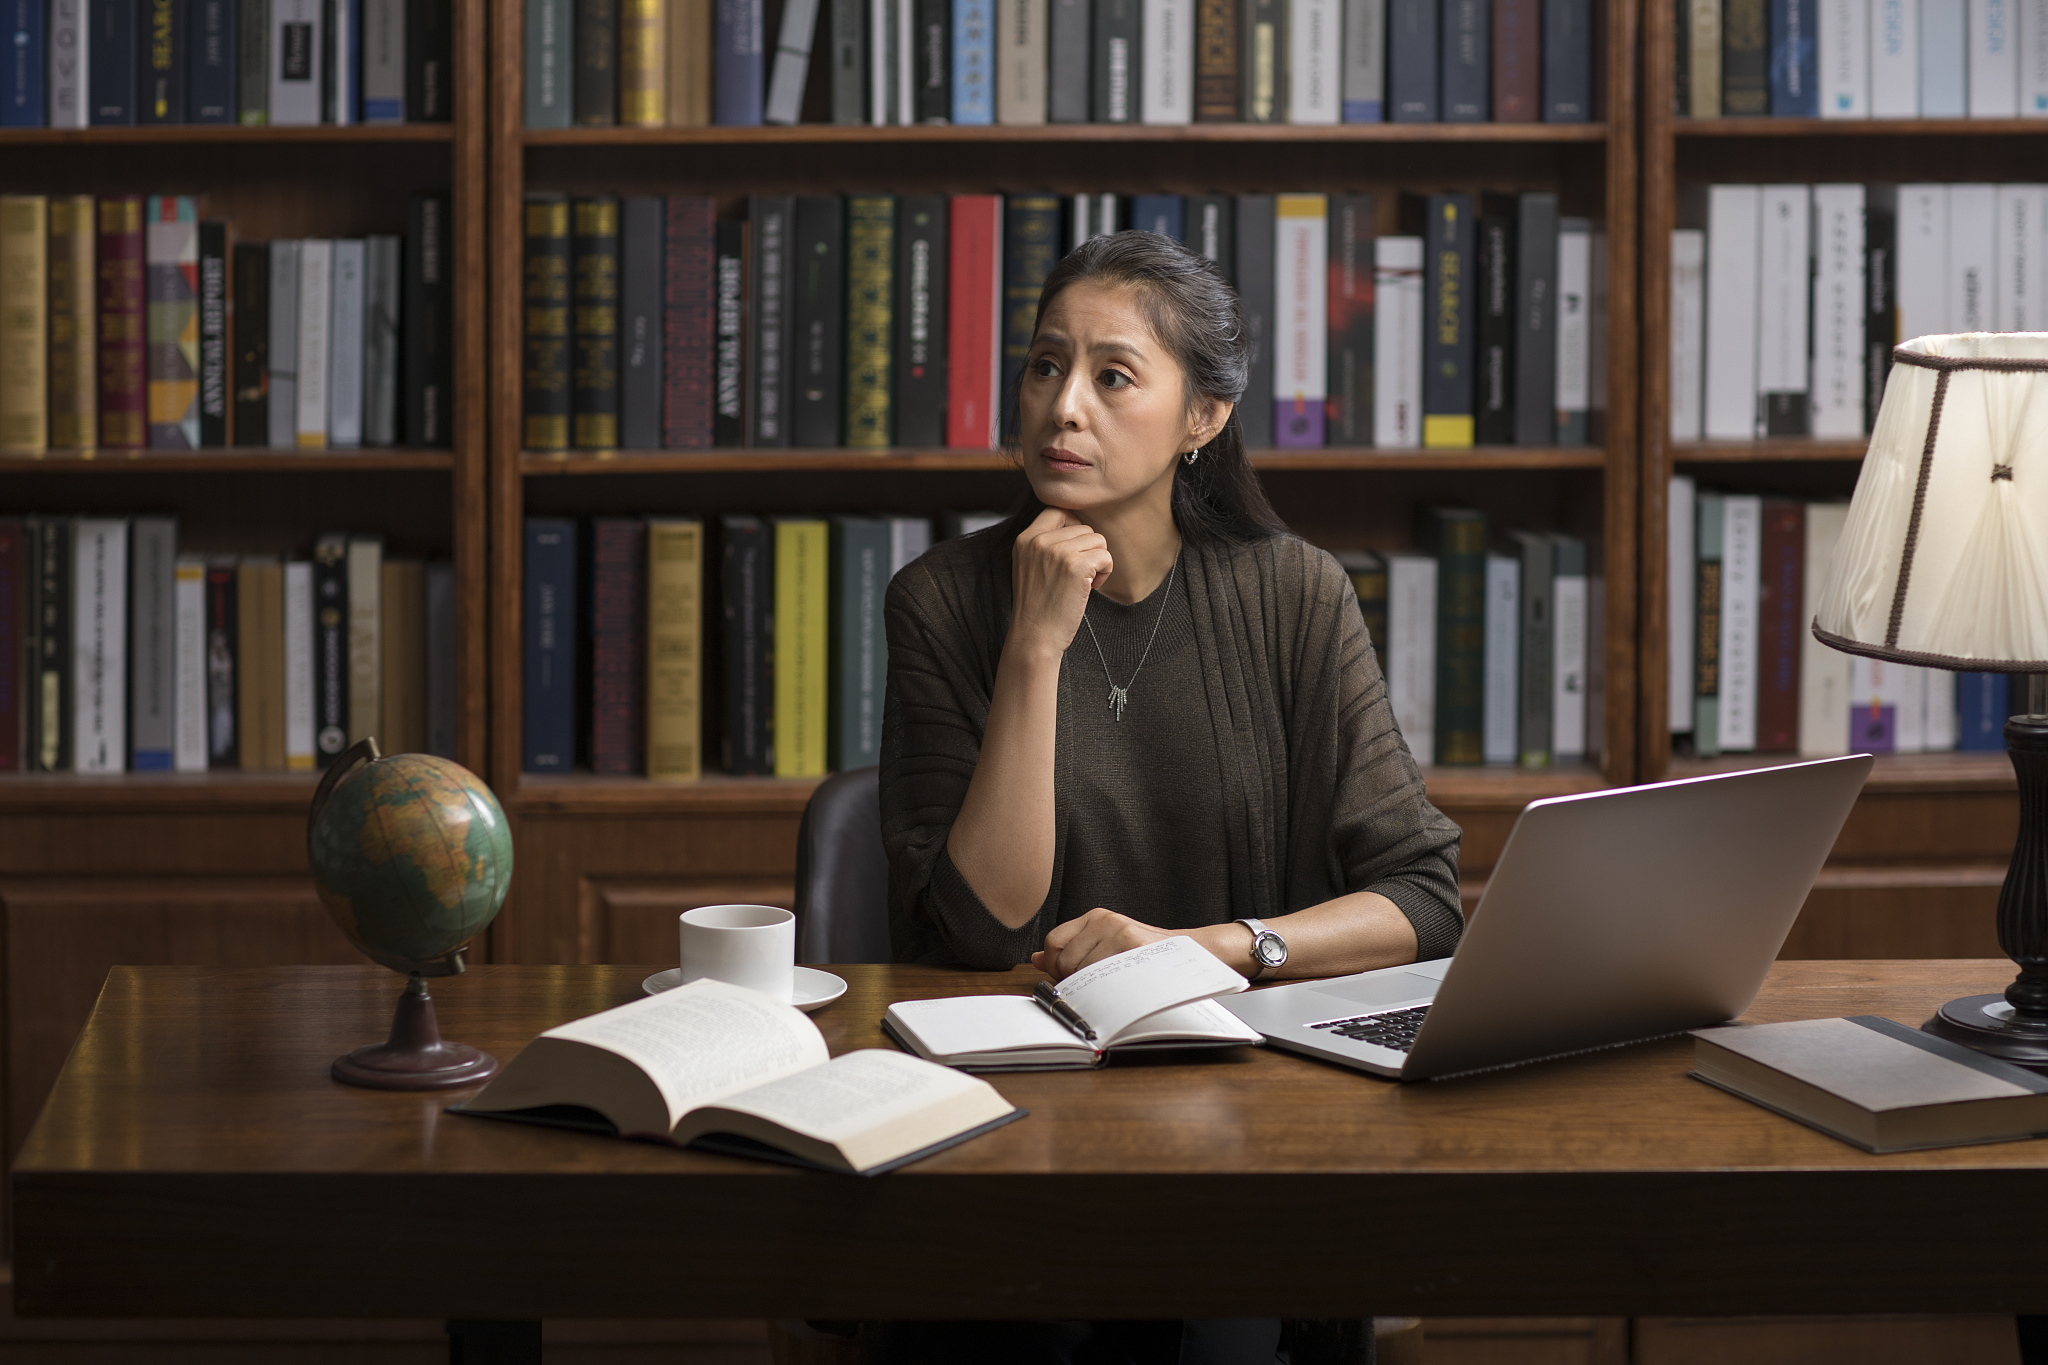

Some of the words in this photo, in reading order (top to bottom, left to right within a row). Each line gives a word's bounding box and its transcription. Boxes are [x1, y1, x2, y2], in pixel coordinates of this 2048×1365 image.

[202, 256, 225, 335] REPORT
[717, 255, 741, 335] REPORT
[1438, 251, 1461, 346] SEARCH
[202, 336, 225, 419] ANNUAL
[717, 336, 741, 419] ANNUAL
